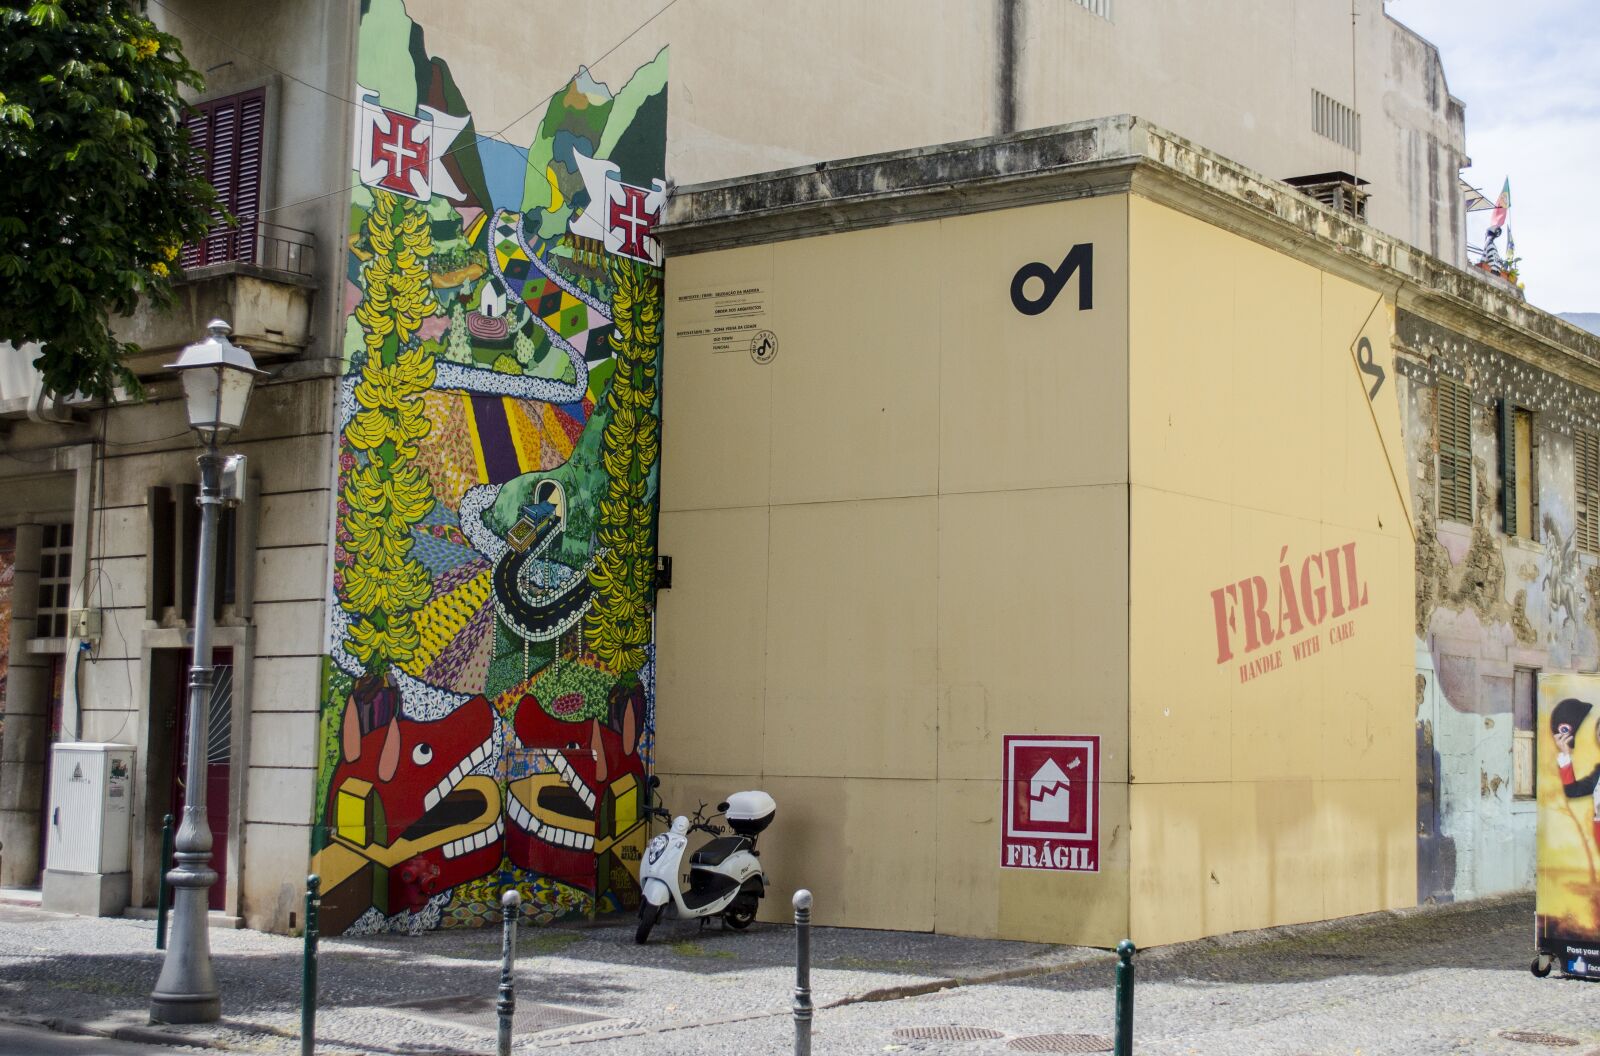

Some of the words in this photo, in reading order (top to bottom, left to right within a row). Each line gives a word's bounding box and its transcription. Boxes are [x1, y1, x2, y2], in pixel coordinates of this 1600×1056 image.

[1210, 542, 1369, 665] FRÁGIL
[1239, 650, 1283, 684] HANDLE
[1292, 635, 1320, 662] WITH
[1329, 620, 1355, 645] CARE
[1006, 840, 1094, 870] FRÁGIL
[1566, 945, 1582, 954] Post
[1583, 948, 1600, 956] your
